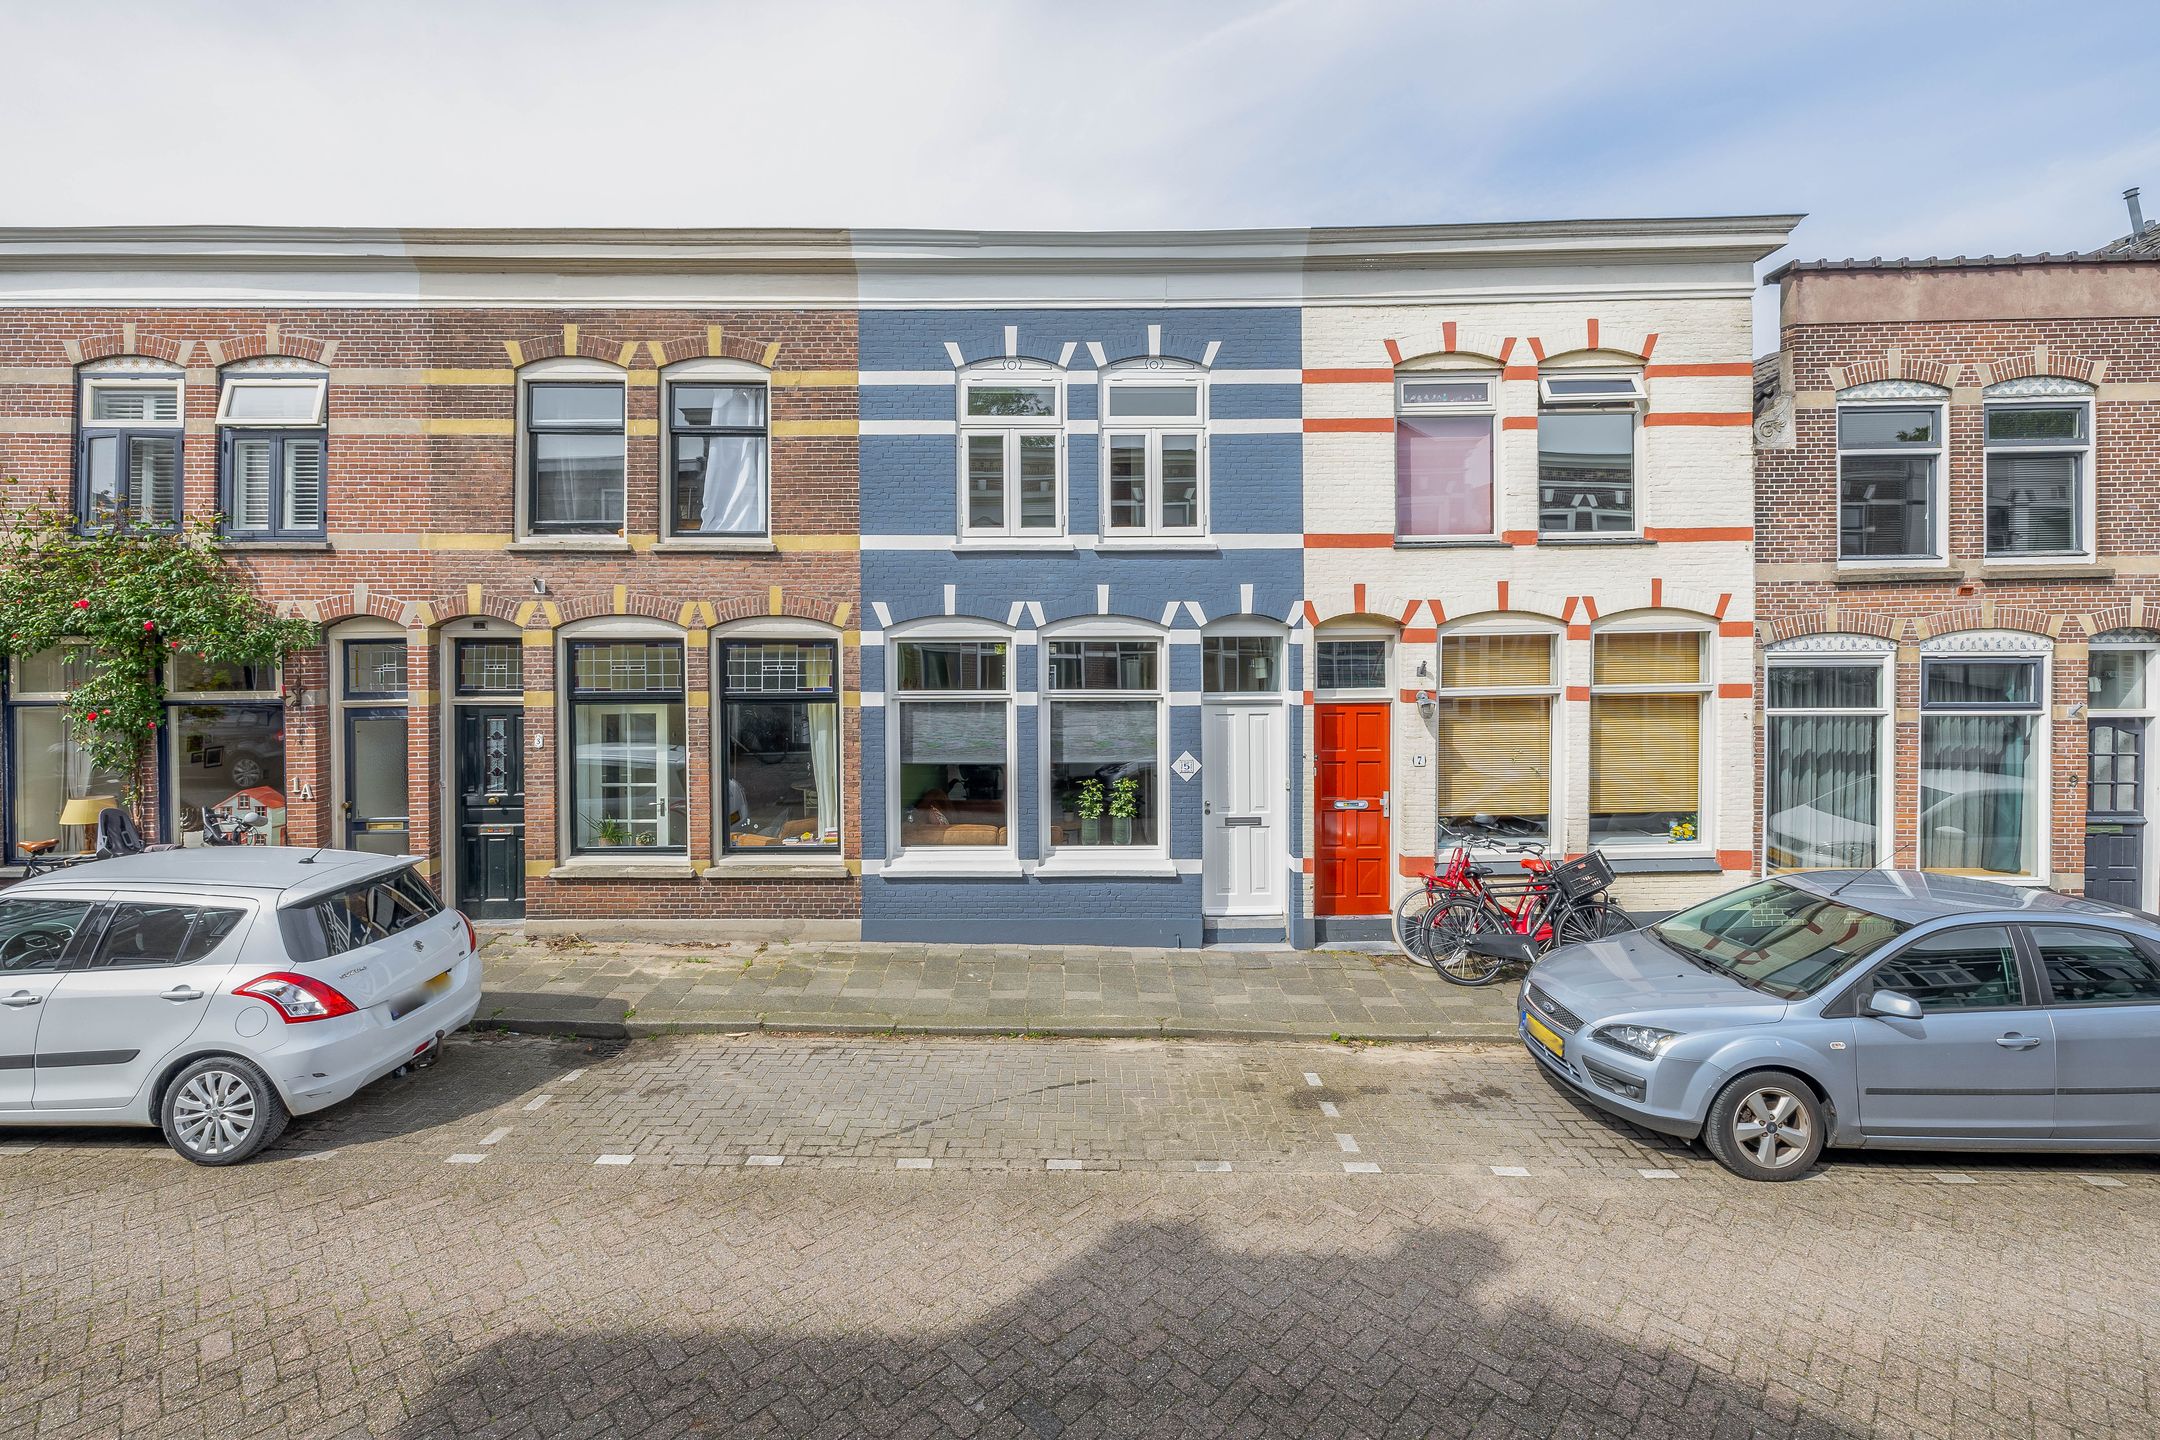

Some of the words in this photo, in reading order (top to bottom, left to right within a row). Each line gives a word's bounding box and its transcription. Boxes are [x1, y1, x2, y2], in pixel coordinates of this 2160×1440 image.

[1183, 763, 1190, 771] 5
[290, 776, 314, 800] 1A
[2069, 775, 2078, 788] 9
